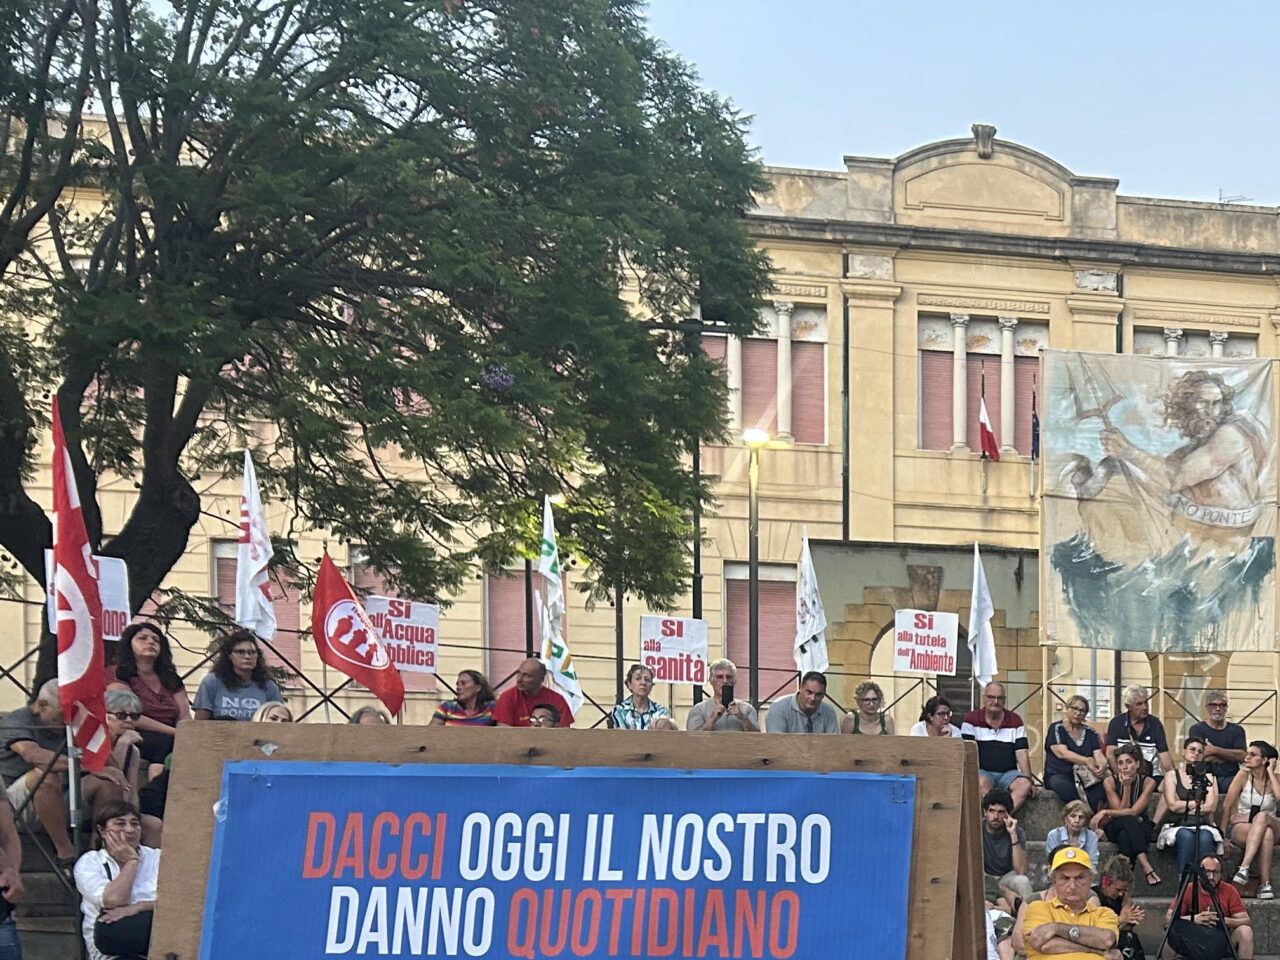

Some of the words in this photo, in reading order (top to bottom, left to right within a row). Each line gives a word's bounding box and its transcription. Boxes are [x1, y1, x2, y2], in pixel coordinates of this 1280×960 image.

[1176, 496, 1199, 516] NO
[1201, 509, 1251, 525] PONTE
[661, 620, 684, 637] SI
[914, 613, 934, 630] Si
[643, 638, 661, 652] alla
[897, 630, 913, 642] alla
[915, 632, 947, 648] tutela
[645, 653, 705, 683] sanità
[221, 696, 261, 708] NO
[221, 709, 256, 719] PONT
[302, 812, 447, 880] DACCI
[458, 812, 570, 882] OGGI
[582, 813, 624, 882] IL
[638, 813, 832, 885] NOSTRO
[324, 886, 496, 957] DANNO
[506, 887, 801, 960] QUOTIDIANO
